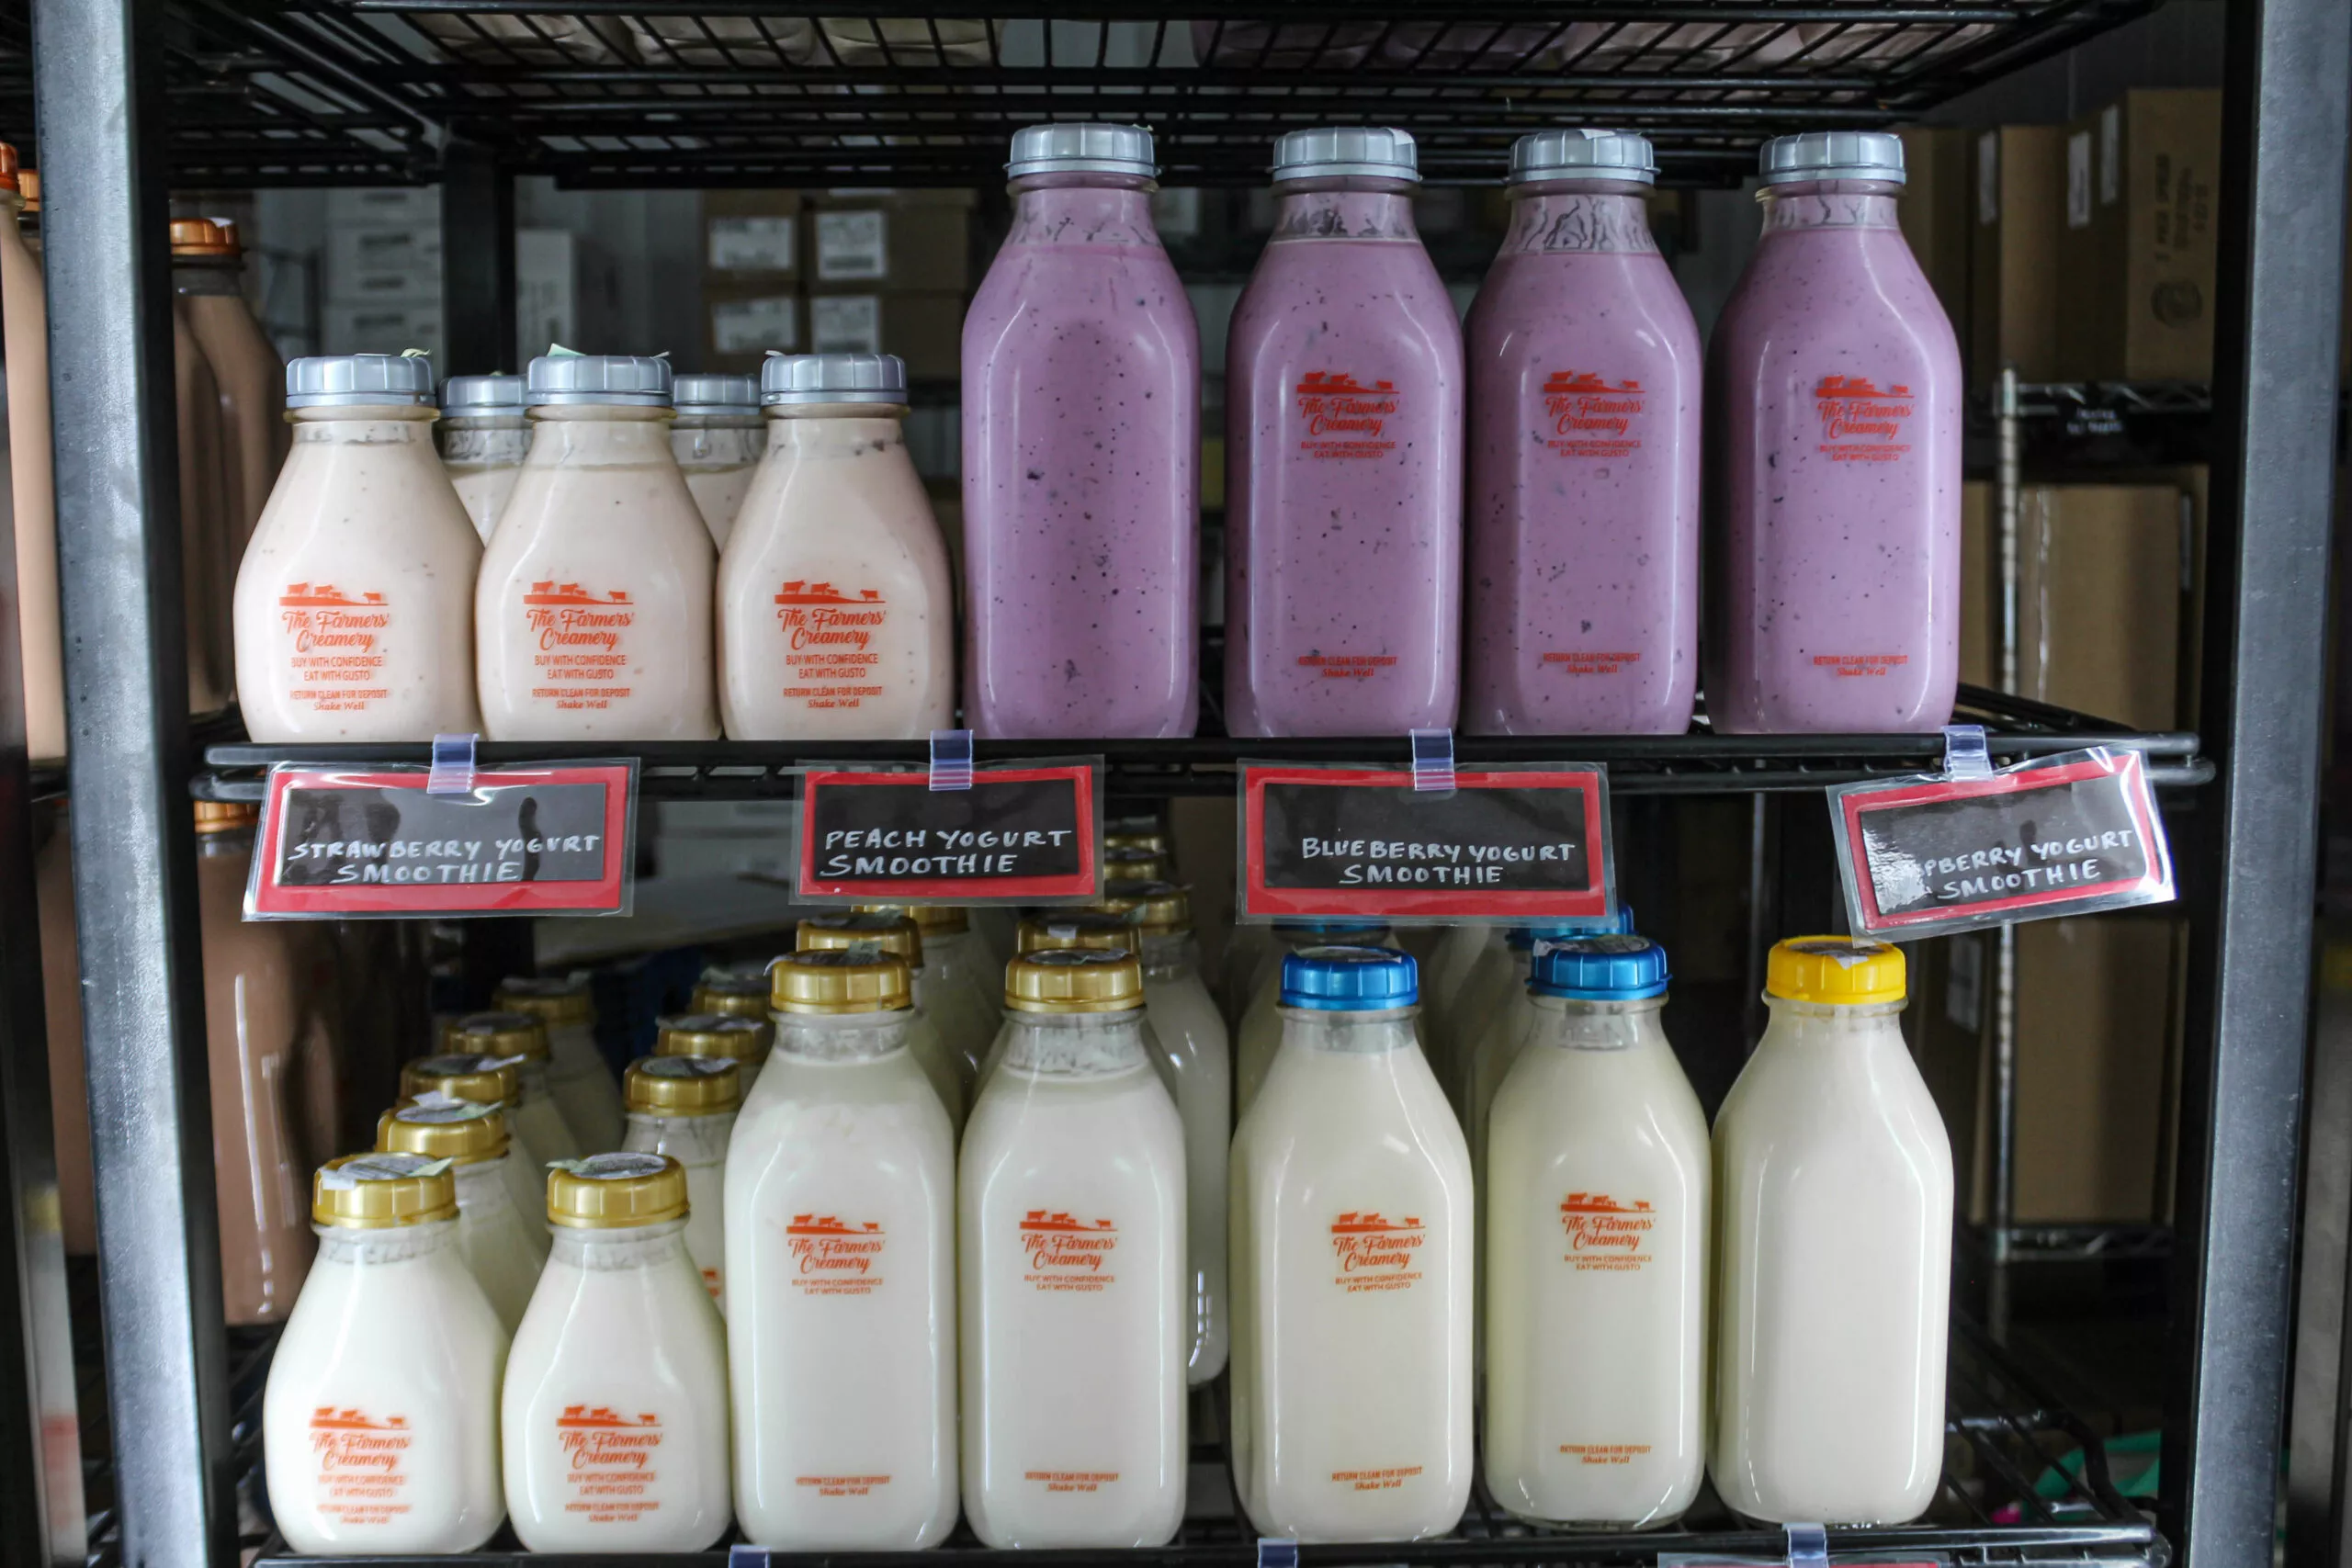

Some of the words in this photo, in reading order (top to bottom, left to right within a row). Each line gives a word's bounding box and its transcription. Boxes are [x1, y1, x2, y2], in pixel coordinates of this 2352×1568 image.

[1298, 397, 1325, 418] The
[1545, 397, 1571, 418] The
[1817, 401, 1844, 423] The
[1310, 414, 1383, 436] Creamery
[1557, 413, 1628, 436] Creamery
[1828, 419, 1899, 440] Creamery
[281, 611, 310, 634] The
[526, 609, 555, 632] The
[777, 609, 806, 632] The
[296, 630, 375, 652] Creamery
[539, 627, 617, 651] Creamery
[791, 627, 869, 650] Creamery
[291, 658, 308, 667] BUY
[310, 658, 329, 667] WITH
[332, 657, 382, 666] CONFIDENCE
[535, 656, 550, 665] BUY
[553, 656, 572, 665] WITH
[575, 655, 626, 665] CONFIDENCE
[786, 655, 802, 665] BUY
[804, 655, 824, 664] WITH
[827, 654, 878, 664] CONFIDENCE
[304, 671, 319, 681] EAT
[321, 671, 341, 681] WITH
[343, 671, 370, 680] GUSTO
[548, 670, 561, 679] EAT
[564, 670, 583, 679] WITH
[586, 670, 614, 679] GUSTO
[798, 669, 814, 679] EAT
[816, 669, 835, 678] WITH
[838, 668, 865, 677] GUSTO
[290, 691, 316, 699] RETURN
[343, 690, 356, 698] FOR
[358, 690, 387, 698] DEPOSIT
[532, 689, 559, 697] RETURN
[561, 689, 583, 697] CLEAN
[585, 689, 598, 697] FOR
[602, 688, 629, 697] DEPOSIT
[784, 688, 810, 696] RETURN
[813, 687, 834, 696] CLEAN
[837, 687, 851, 695] FOR
[854, 686, 882, 695] DEPOSIT
[313, 702, 340, 710] Shake
[808, 699, 834, 707] Shake
[839, 699, 859, 707] Well
[288, 840, 481, 862] STRAWBERRY
[496, 836, 599, 860] YOGURT
[825, 829, 926, 850] PEACH
[937, 830, 1071, 850] YOGURT
[2031, 830, 2133, 860] YOGURT
[1303, 838, 1461, 863] BLUEBERRY
[1469, 844, 1575, 863] YOGURT
[332, 862, 521, 883] SMOOTHIE
[820, 853, 1017, 876] SMOOTHIE
[1340, 864, 1503, 885] SMOOTHIE
[1937, 859, 2100, 900] SMOOTHIE
[1563, 1215, 1586, 1235] The
[788, 1238, 813, 1258] The
[1022, 1235, 1046, 1253] The
[1333, 1236, 1358, 1257] The
[1573, 1232, 1639, 1251] Creamery
[800, 1256, 871, 1274] Creamery
[1033, 1250, 1102, 1271] Creamery
[1344, 1252, 1410, 1271] Creamery
[1374, 1272, 1422, 1282] CONFIDENCE
[310, 1432, 336, 1453] The
[559, 1431, 587, 1452] The
[322, 1450, 397, 1471] Creamery
[572, 1449, 647, 1469] Creamery
[1332, 1472, 1357, 1481] RETURN
[1360, 1471, 1380, 1479] CLEAN
[1396, 1467, 1421, 1476] DEPOSIT
[1355, 1482, 1379, 1490] Shake
[1384, 1479, 1401, 1488] Well
